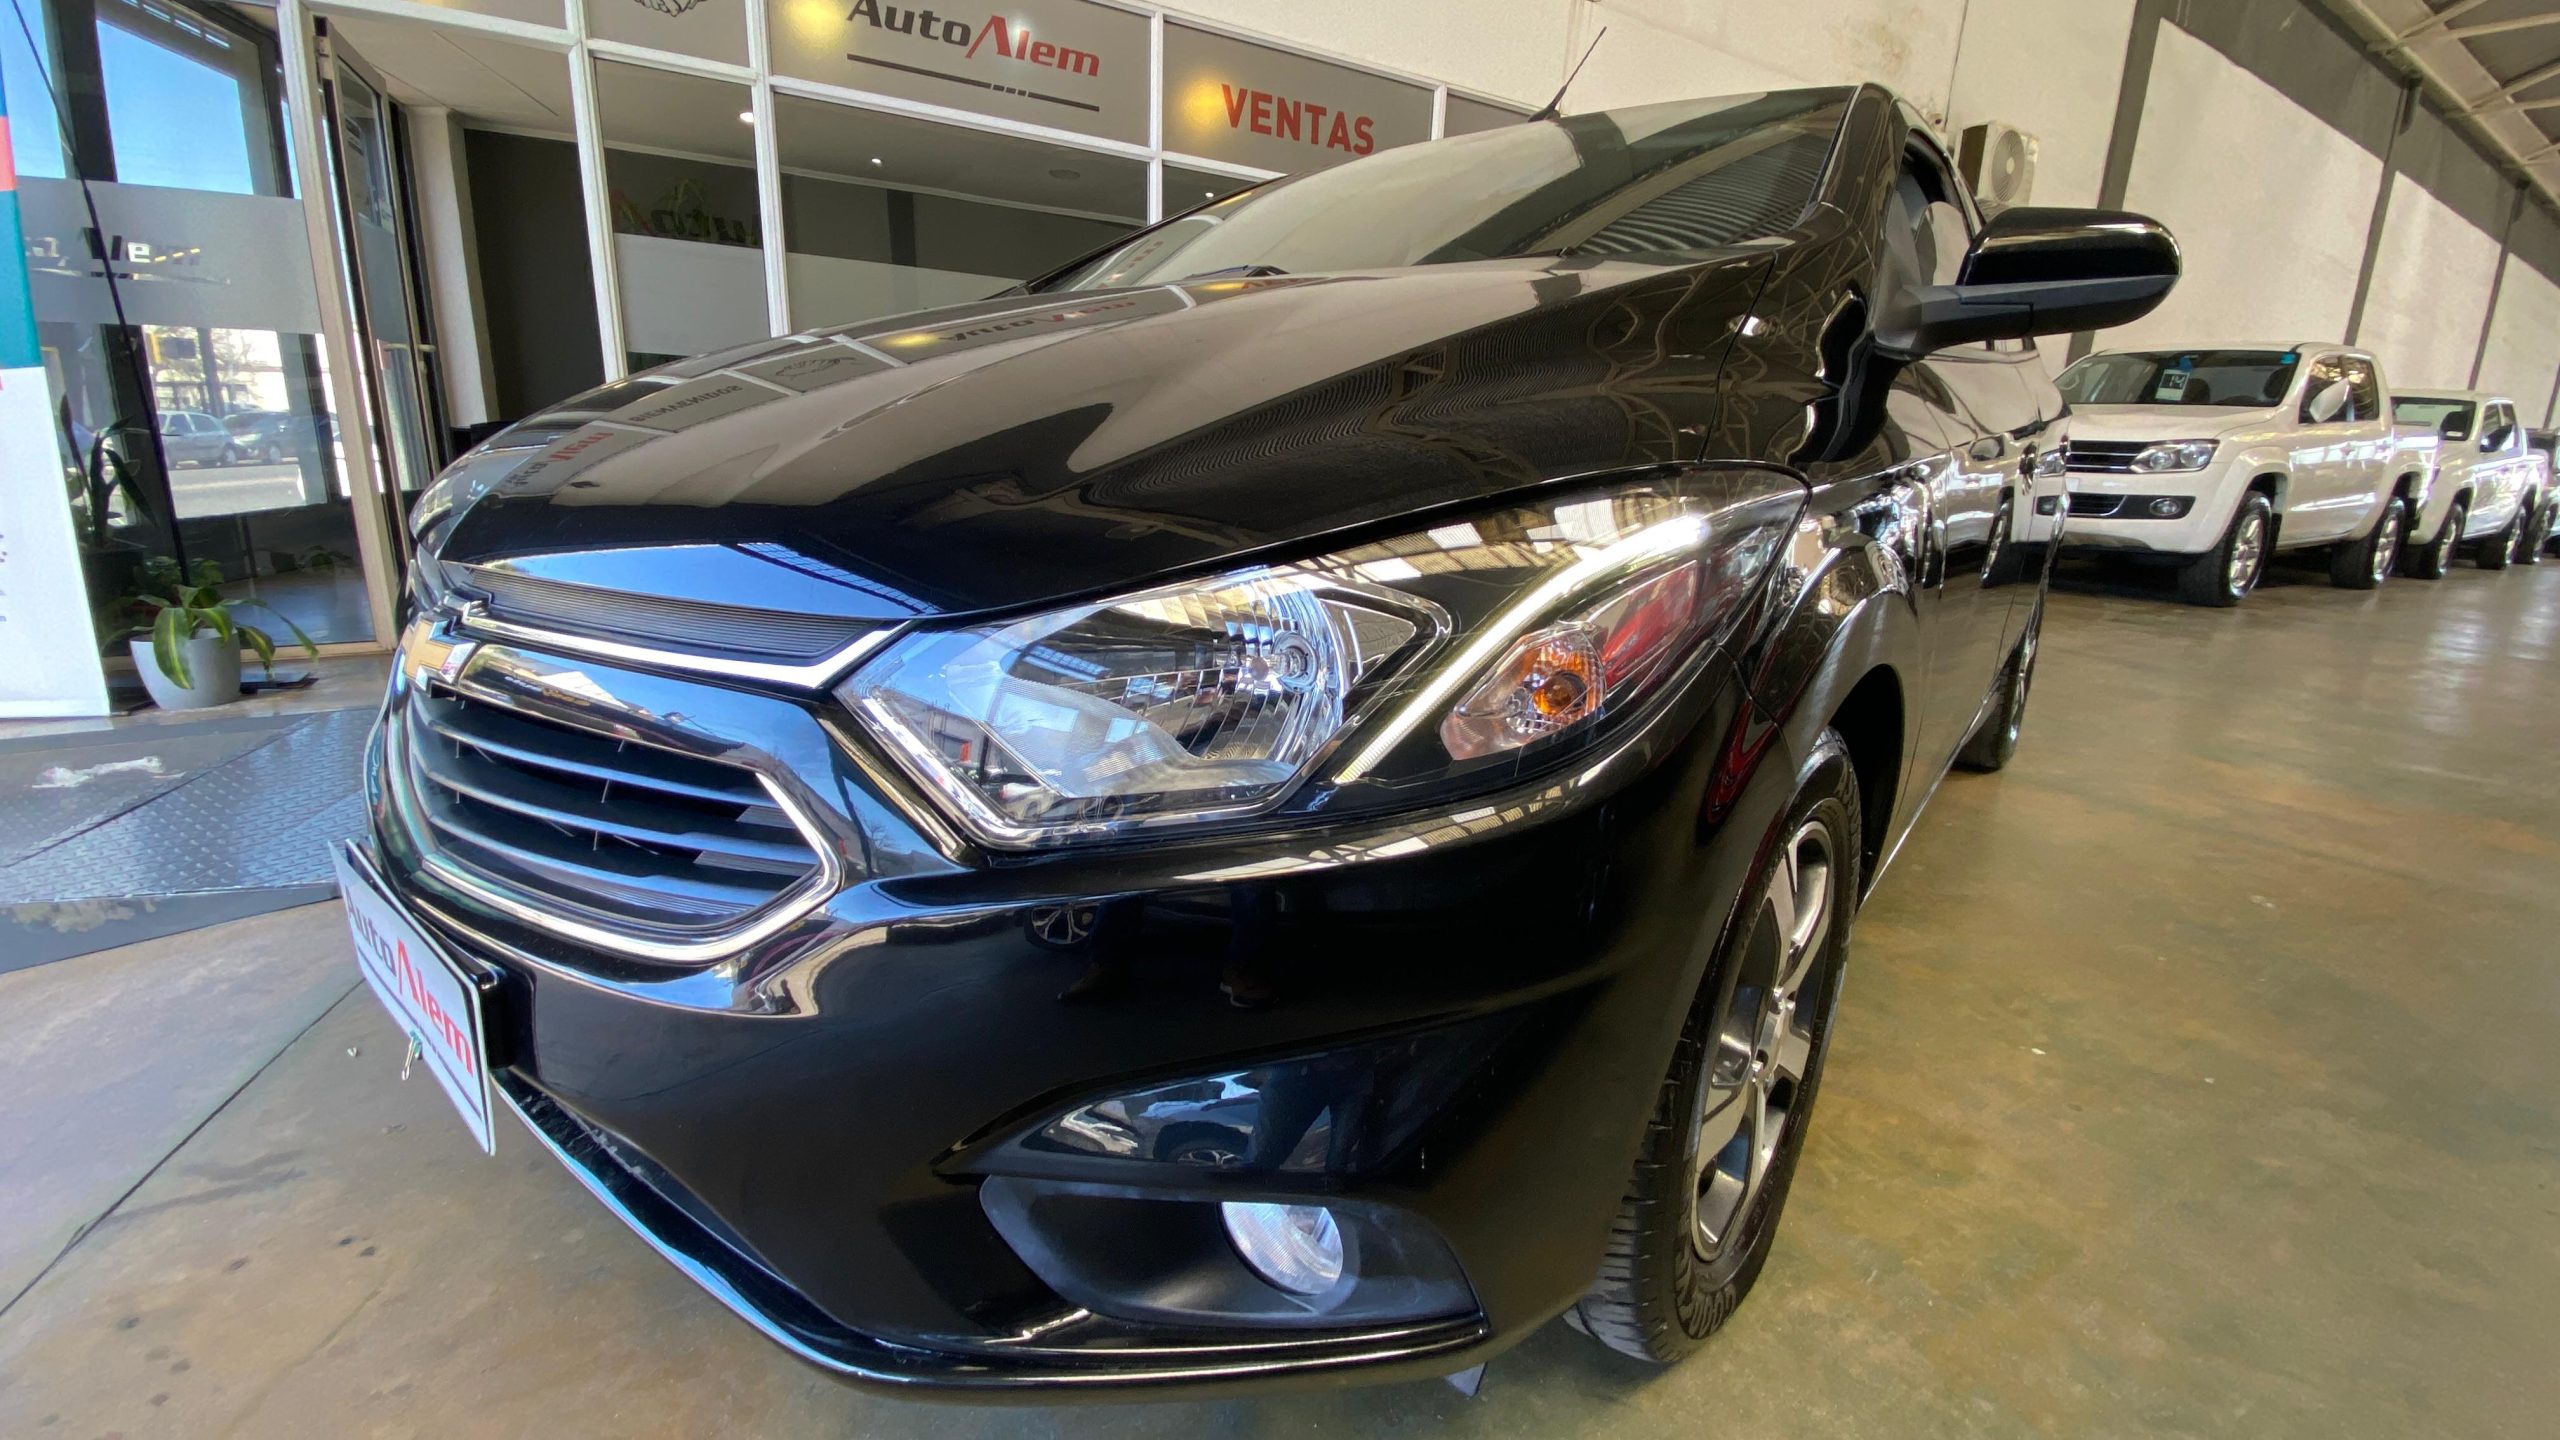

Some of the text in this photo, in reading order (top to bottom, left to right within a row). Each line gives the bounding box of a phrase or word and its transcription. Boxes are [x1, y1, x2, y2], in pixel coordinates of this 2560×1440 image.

[847, 0, 1100, 77] AutoAlem
[1221, 84, 1375, 156] VENTAS
[345, 884, 474, 1079] AutoAlem
